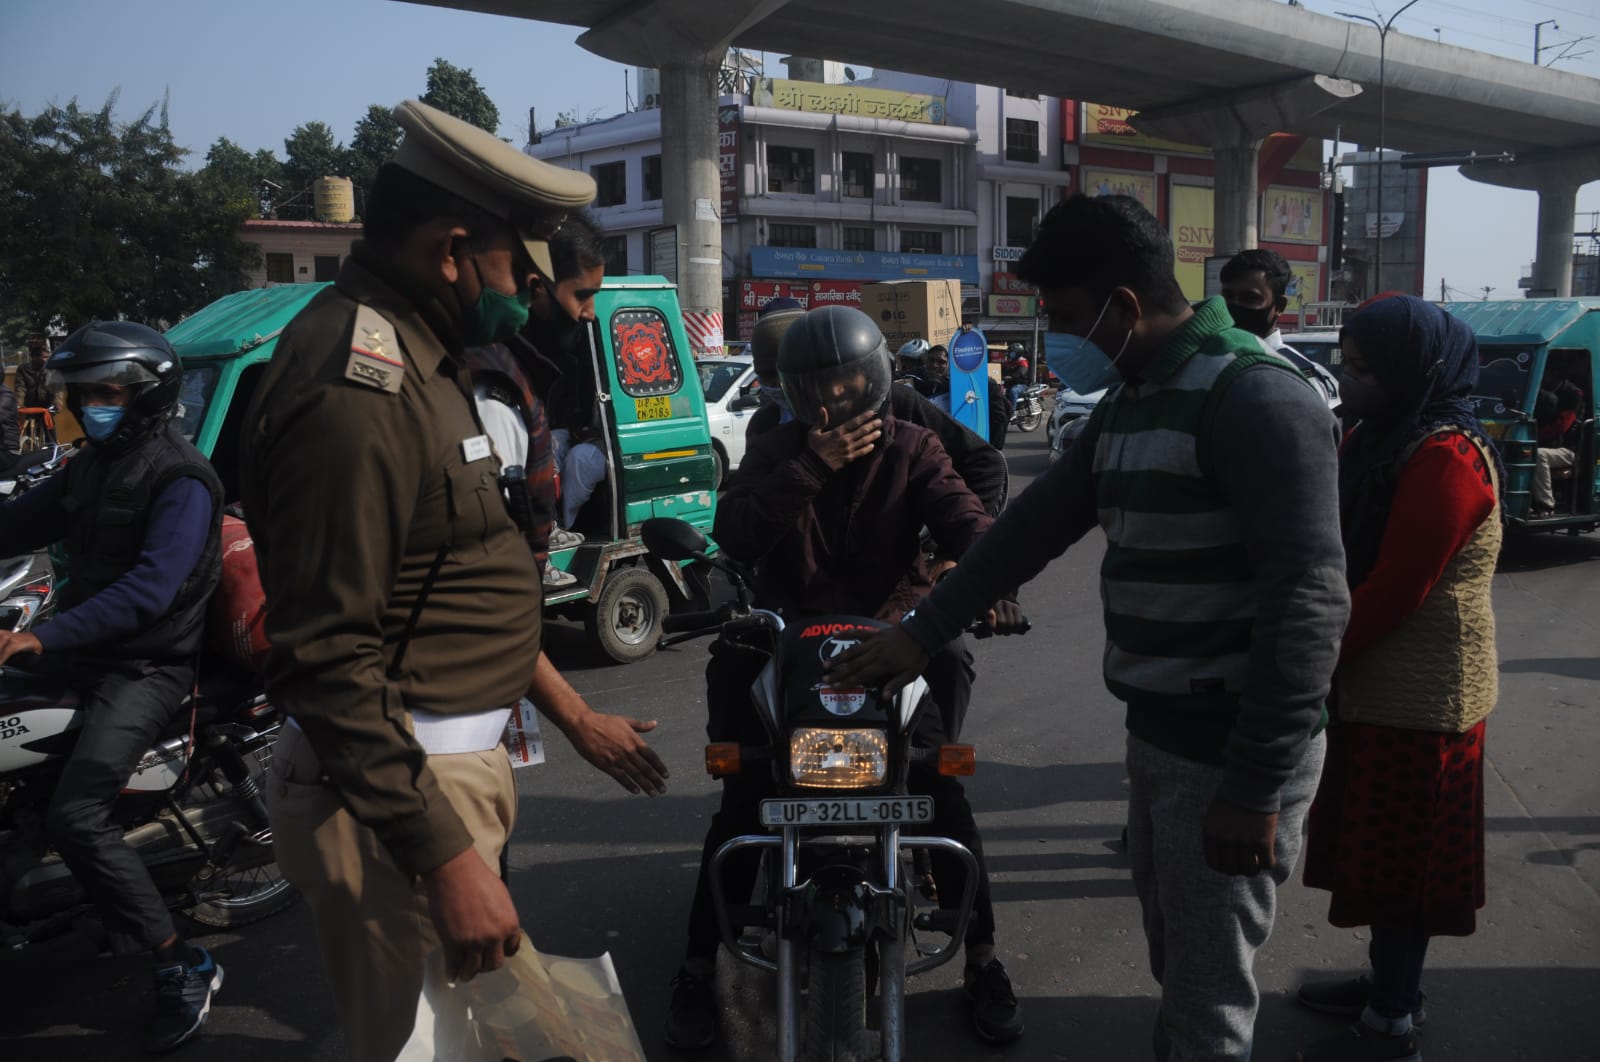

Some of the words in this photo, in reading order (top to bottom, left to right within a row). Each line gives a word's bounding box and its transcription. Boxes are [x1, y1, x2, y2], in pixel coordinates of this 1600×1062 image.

[779, 87, 803, 107] श्री
[744, 291, 755, 306] श्री
[815, 289, 844, 302] सागरिका
[800, 624, 881, 638] ADVOC
[0, 717, 21, 729] RO
[784, 803, 807, 821] UP
[818, 803, 867, 821] 32LL
[879, 801, 929, 819] 0615
